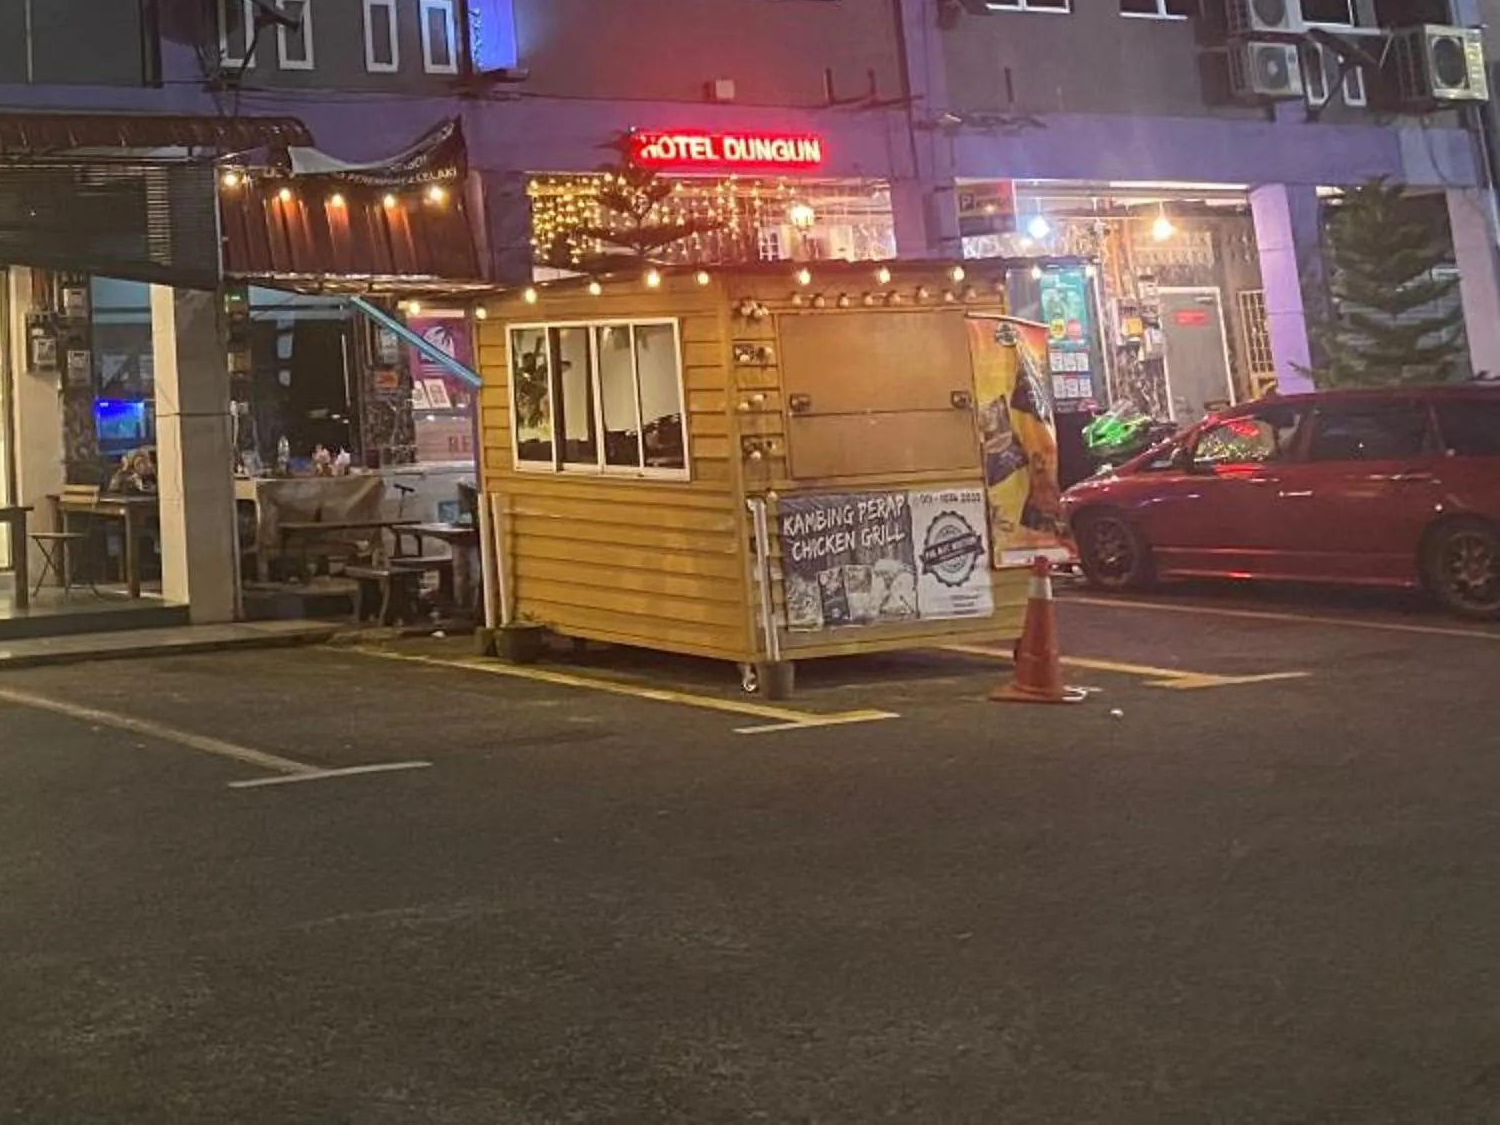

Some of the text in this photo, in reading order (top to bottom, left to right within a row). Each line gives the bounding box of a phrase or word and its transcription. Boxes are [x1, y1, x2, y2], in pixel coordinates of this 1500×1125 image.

[723, 137, 822, 163] DUNGUN
[782, 504, 855, 537] KAMBING
[857, 494, 906, 524] PERAP
[791, 524, 906, 562] CHICKEN GRILL
